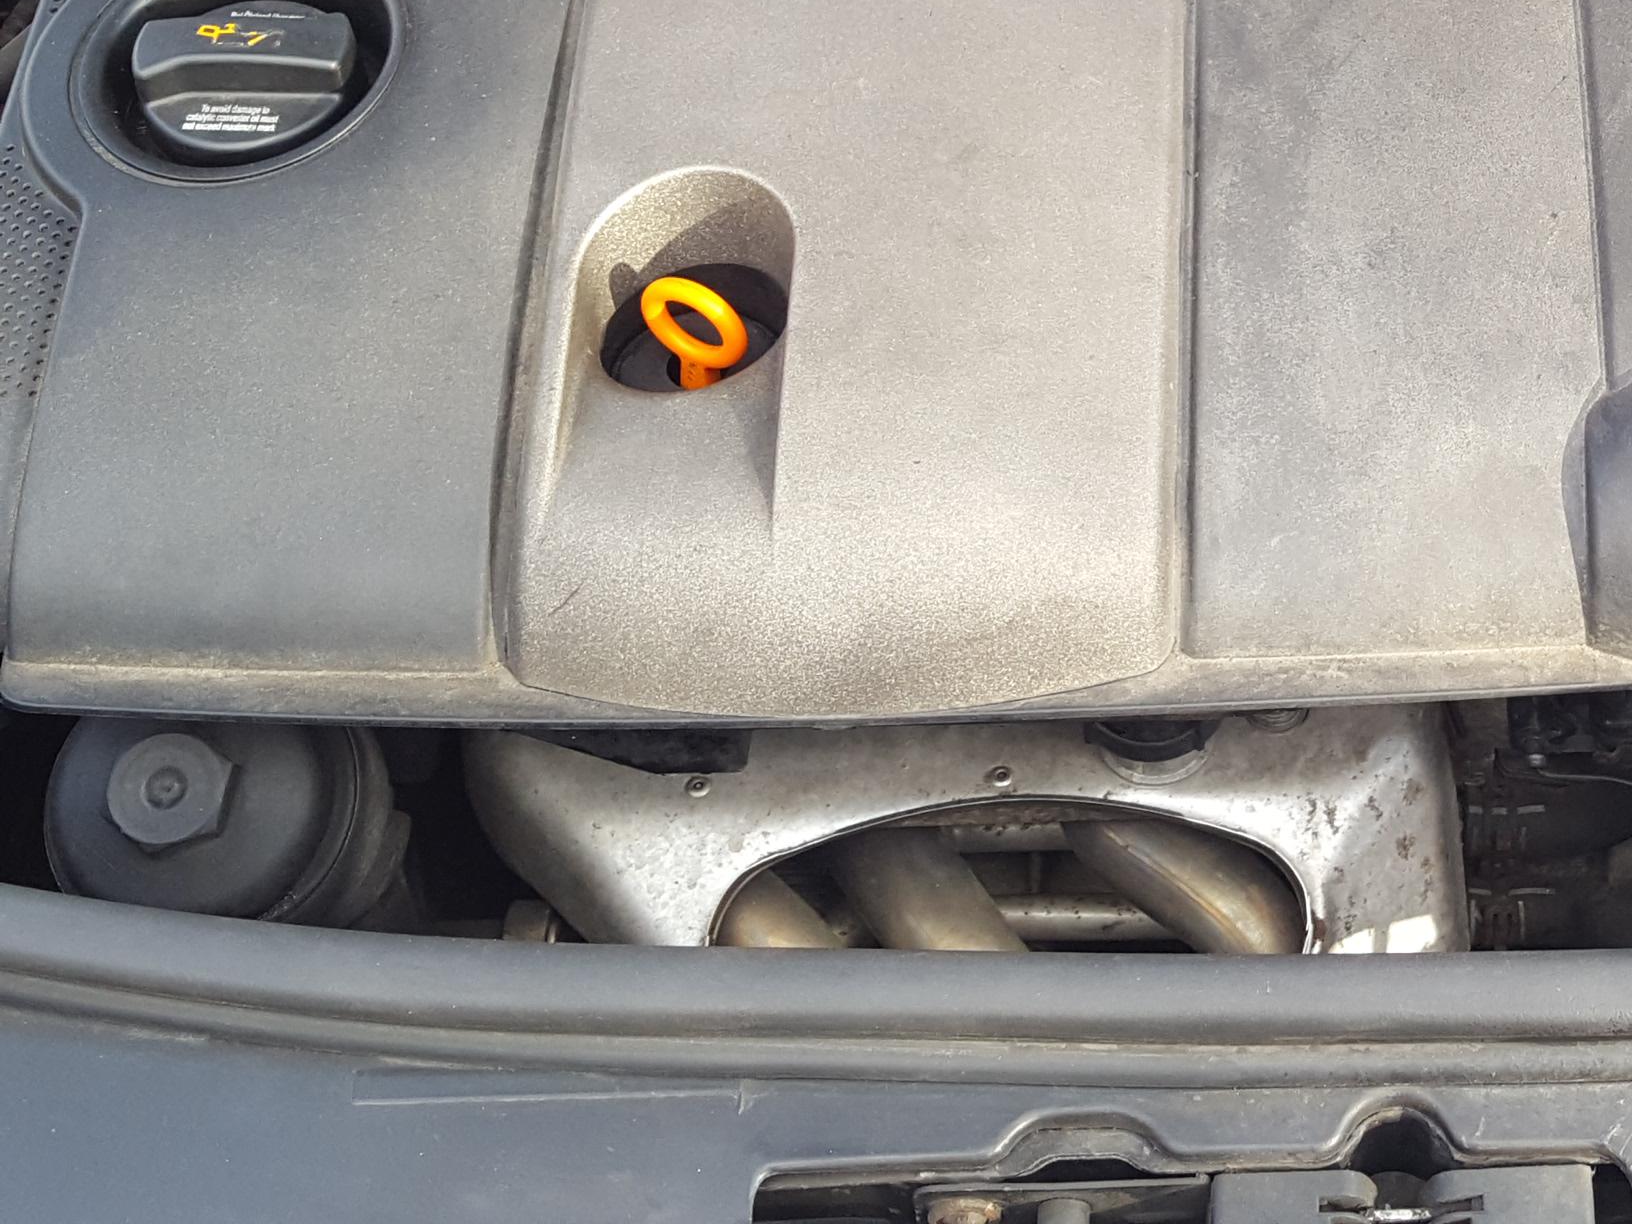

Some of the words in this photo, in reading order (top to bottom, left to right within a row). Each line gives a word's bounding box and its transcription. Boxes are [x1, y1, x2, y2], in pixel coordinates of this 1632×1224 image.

[201, 104, 210, 113] To
[210, 104, 232, 113] avoid
[232, 105, 261, 115] damage
[186, 113, 216, 122] catalytic
